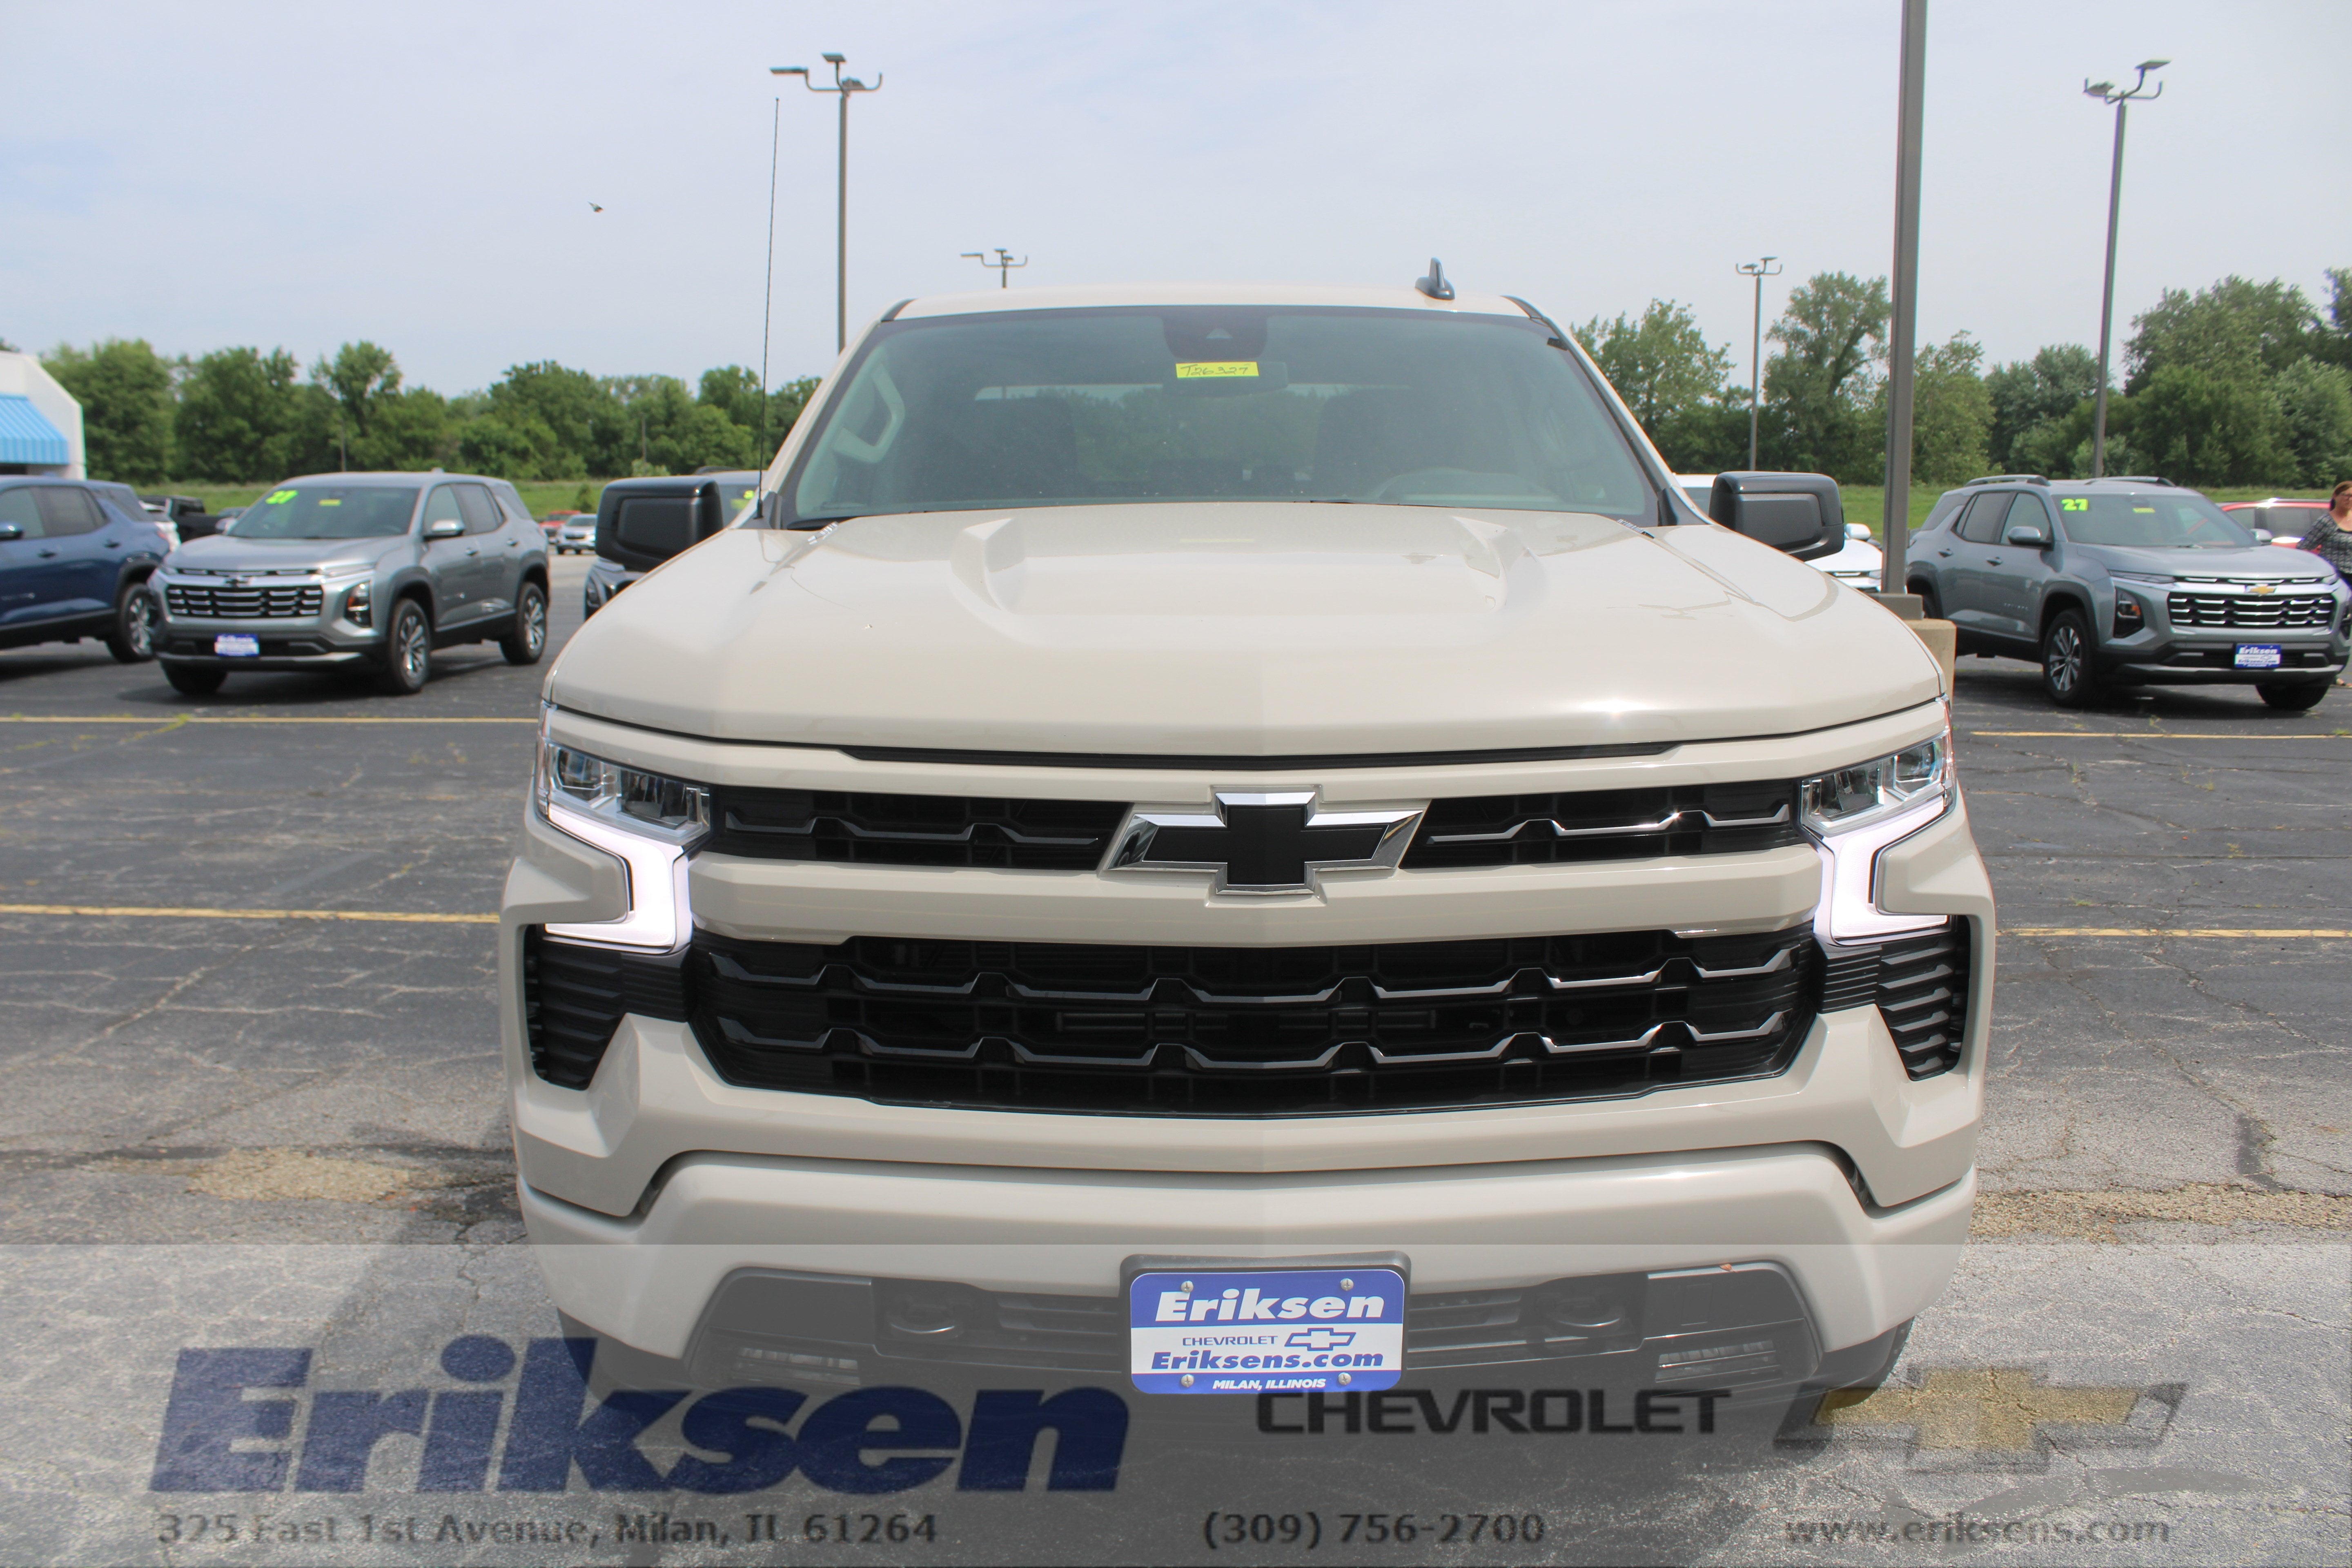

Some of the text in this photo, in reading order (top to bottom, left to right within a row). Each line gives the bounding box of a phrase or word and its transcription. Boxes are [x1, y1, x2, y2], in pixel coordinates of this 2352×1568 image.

[2061, 498, 2089, 511] 27
[1155, 1288, 1385, 1322] Eriksen
[1182, 1335, 1278, 1346] CHEVROLET
[1151, 1350, 1383, 1370] Eriksens.com
[1212, 1378, 1326, 1390] MILAN, ILLINOIS
